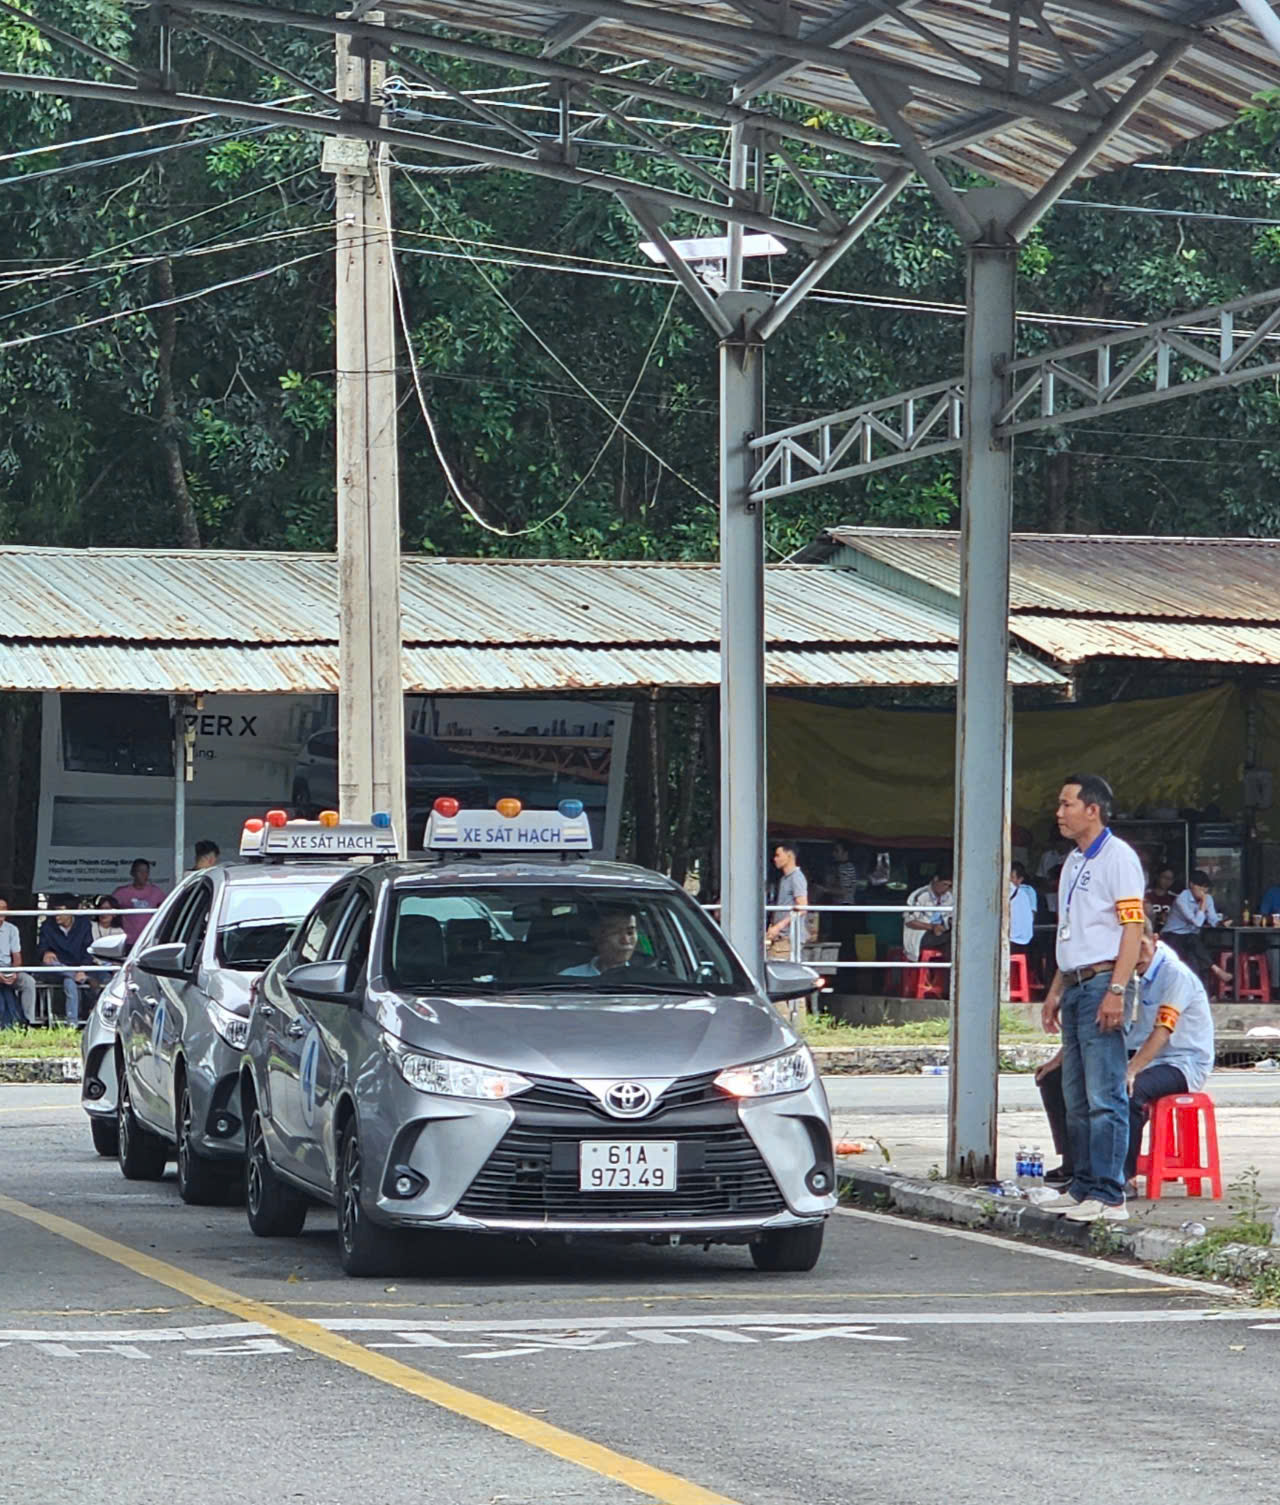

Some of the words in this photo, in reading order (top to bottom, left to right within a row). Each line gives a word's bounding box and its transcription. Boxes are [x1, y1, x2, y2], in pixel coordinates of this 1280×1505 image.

[239, 715, 258, 737] X
[291, 836, 307, 849] XE
[310, 832, 333, 849] SÁT
[463, 827, 482, 843] XE
[486, 824, 513, 843] SÁT
[517, 827, 561, 844] HẠCH
[303, 1041, 316, 1112] 4
[608, 1145, 648, 1165] 61A
[591, 1168, 665, 1187] 973.49
